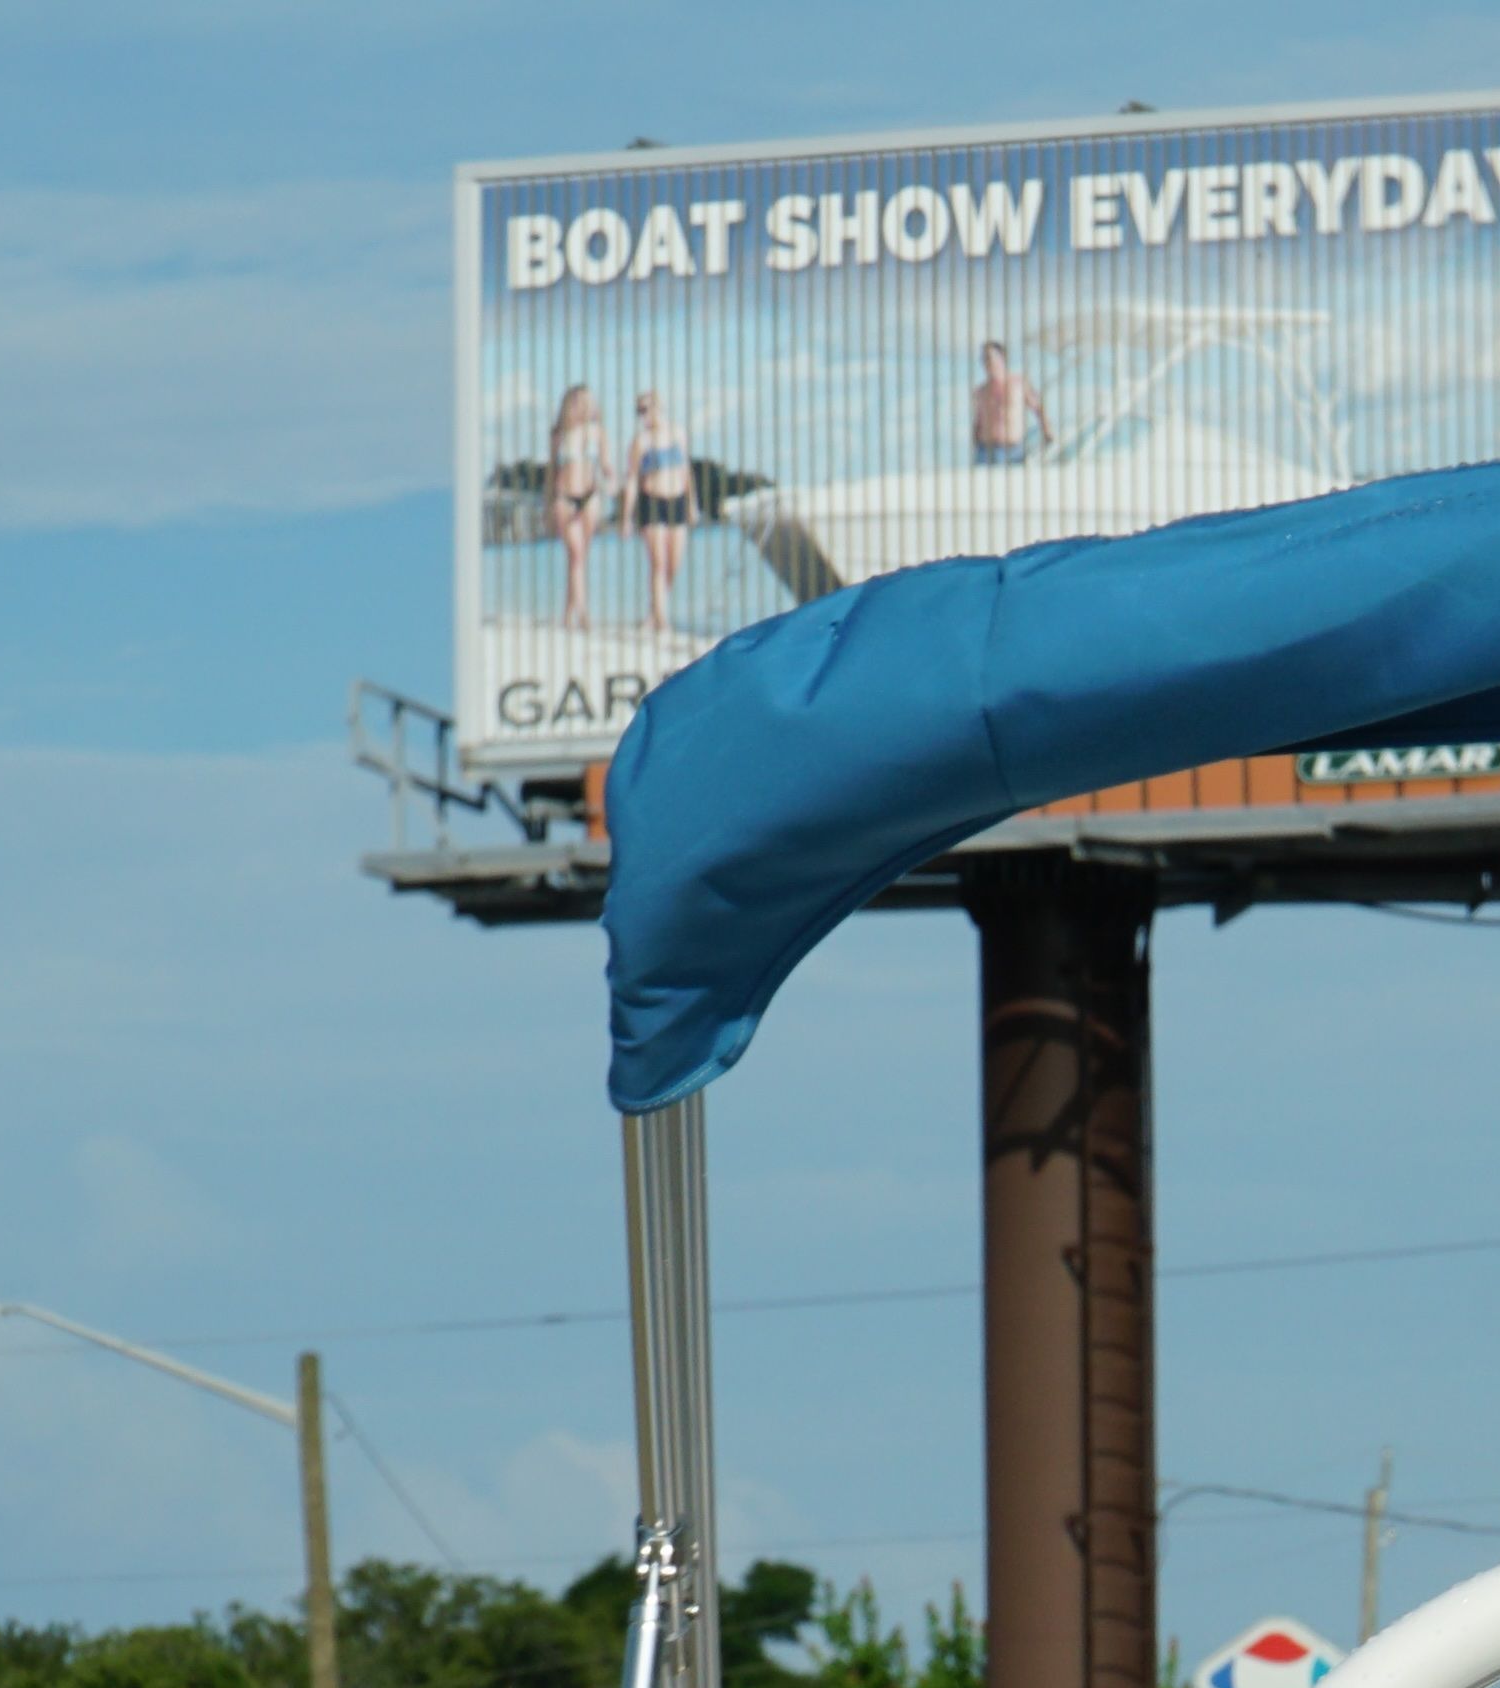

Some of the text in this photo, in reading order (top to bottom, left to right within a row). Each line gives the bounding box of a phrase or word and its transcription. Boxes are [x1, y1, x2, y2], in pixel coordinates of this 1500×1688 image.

[507, 199, 746, 290] BOAT
[764, 178, 1043, 273] SHOW
[1311, 743, 1498, 780] LAMAR
